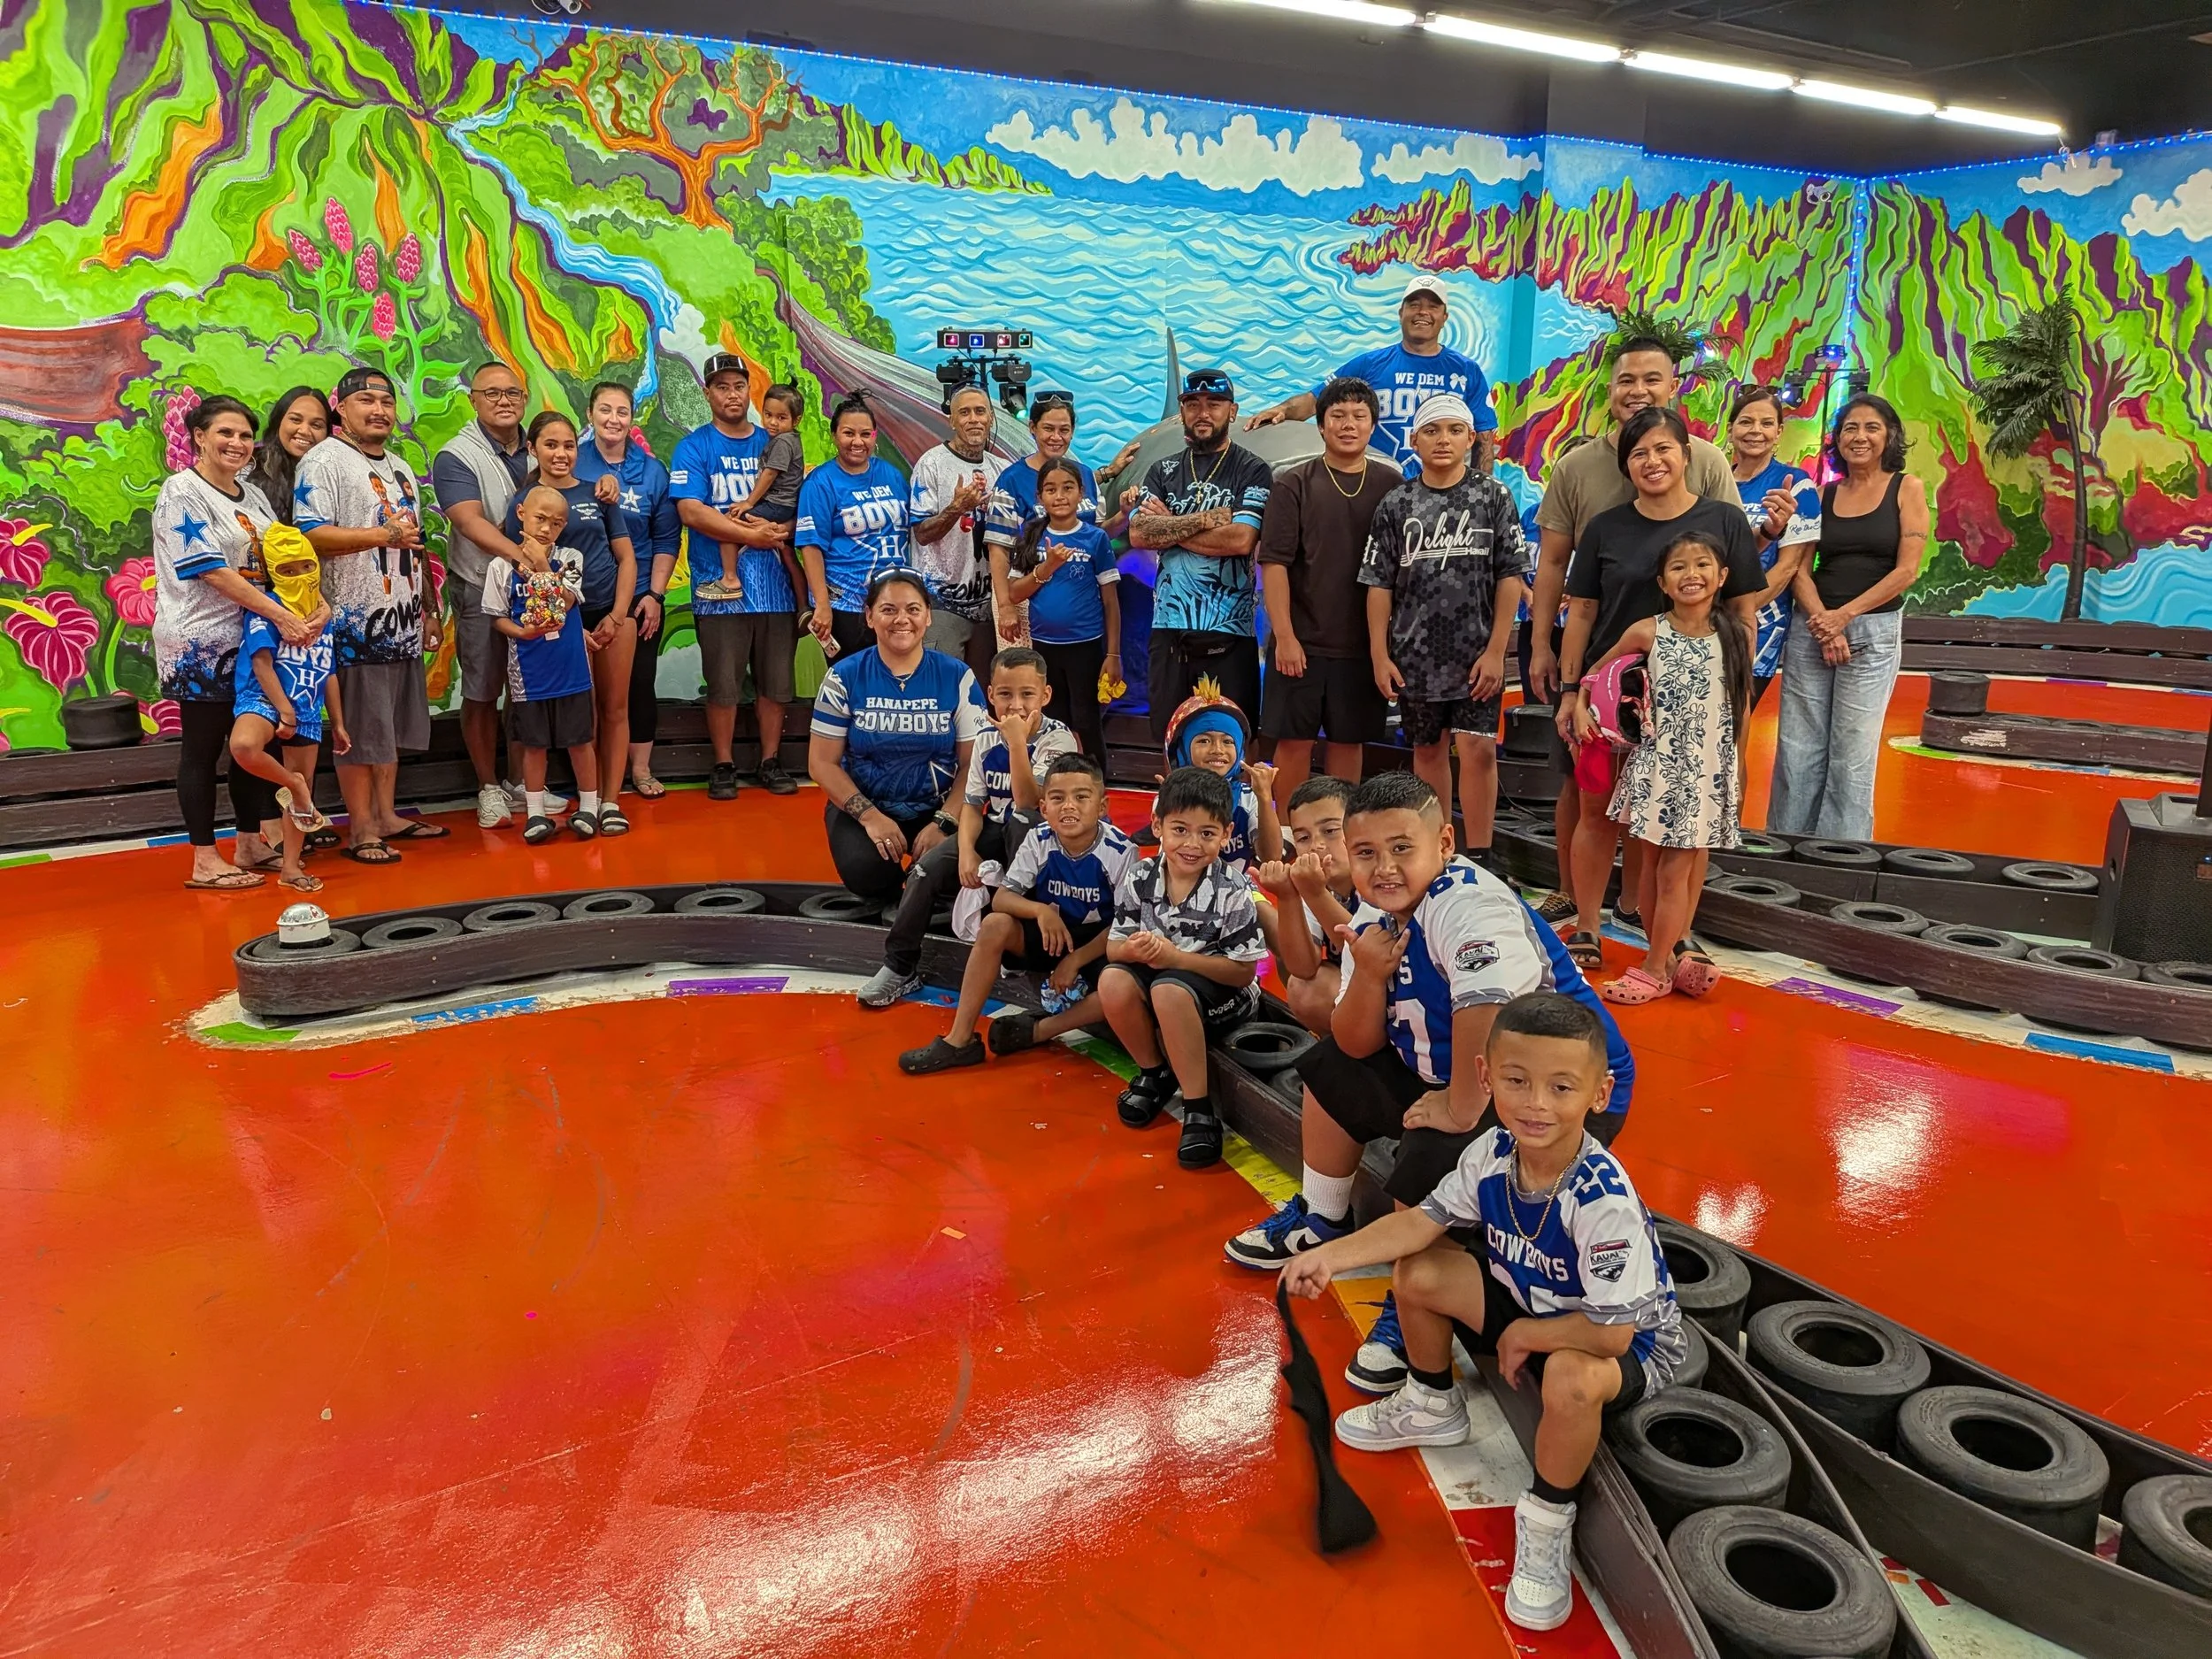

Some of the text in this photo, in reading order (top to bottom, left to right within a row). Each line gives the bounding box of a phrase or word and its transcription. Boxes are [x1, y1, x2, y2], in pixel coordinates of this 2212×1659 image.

[1394, 373, 1445, 386] WE DEM
[720, 456, 741, 470] WE
[852, 485, 894, 502] WE DEM
[1400, 509, 1494, 571] Delight
[296, 666, 317, 688] H
[865, 696, 938, 710] HANAPEPE
[853, 710, 951, 734] COWBOYS
[1048, 879, 1102, 902] COWBOYS
[1568, 1153, 1629, 1209] 22
[1487, 1222, 1569, 1282] COWBOYS
